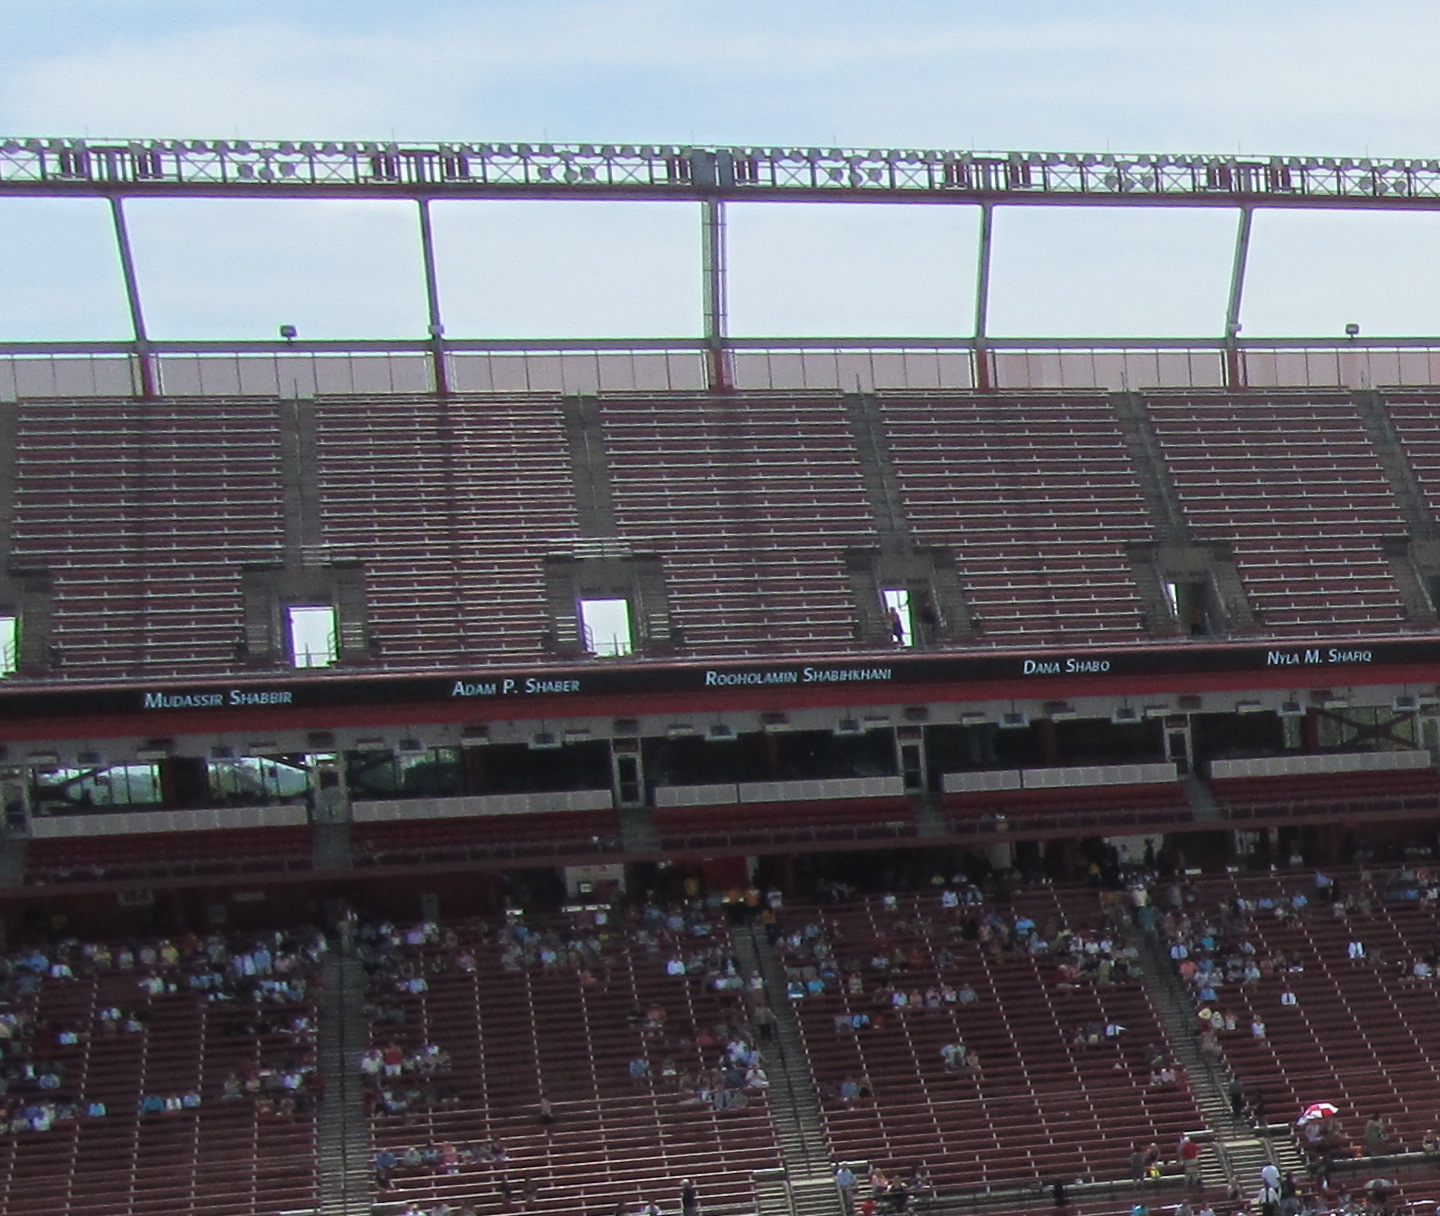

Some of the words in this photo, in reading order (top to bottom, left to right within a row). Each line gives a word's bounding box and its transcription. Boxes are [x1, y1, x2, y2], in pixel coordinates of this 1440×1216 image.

[1267, 650, 1300, 665] NYLA
[1304, 649, 1323, 664] M.
[1328, 648, 1373, 663] SHAFIQ
[1023, 659, 1060, 675] DANA
[1065, 658, 1110, 673] SHABO
[452, 680, 497, 697] ADAM
[502, 678, 519, 694] P.
[525, 677, 580, 694] SHABER
[144, 692, 224, 709] MUDASSIR
[229, 689, 293, 706] SHABBIR
